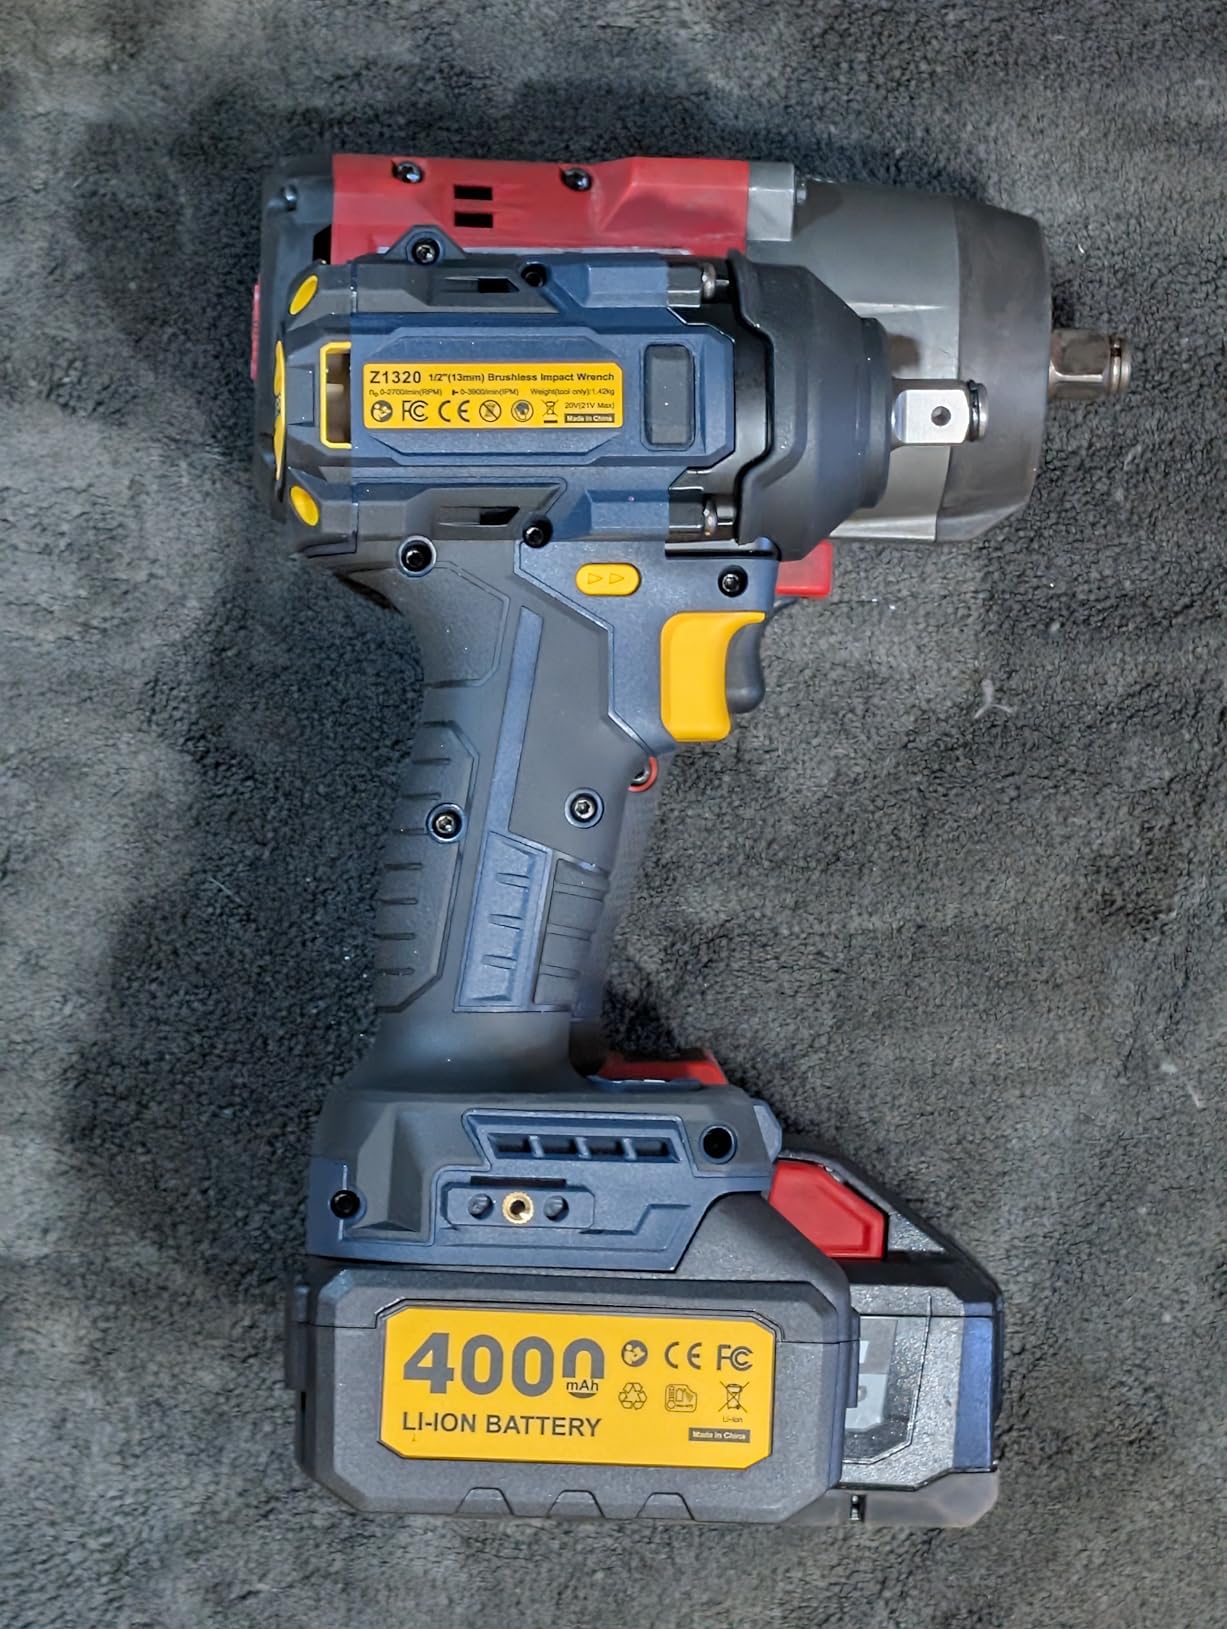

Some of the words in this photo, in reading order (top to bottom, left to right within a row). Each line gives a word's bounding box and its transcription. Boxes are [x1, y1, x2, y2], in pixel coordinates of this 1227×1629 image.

[370, 370, 421, 384] Z1320
[488, 373, 537, 381] Brushless
[540, 373, 574, 382] Impact
[438, 400, 470, 422] CE
[664, 1341, 702, 1370] CE
[403, 1332, 605, 1398] 4000
[566, 1378, 599, 1392] mAh
[402, 1412, 476, 1432] LI-ION
[486, 1414, 602, 1436] BATTERY
[692, 1430, 713, 1439] Made
[724, 1432, 746, 1440] China
